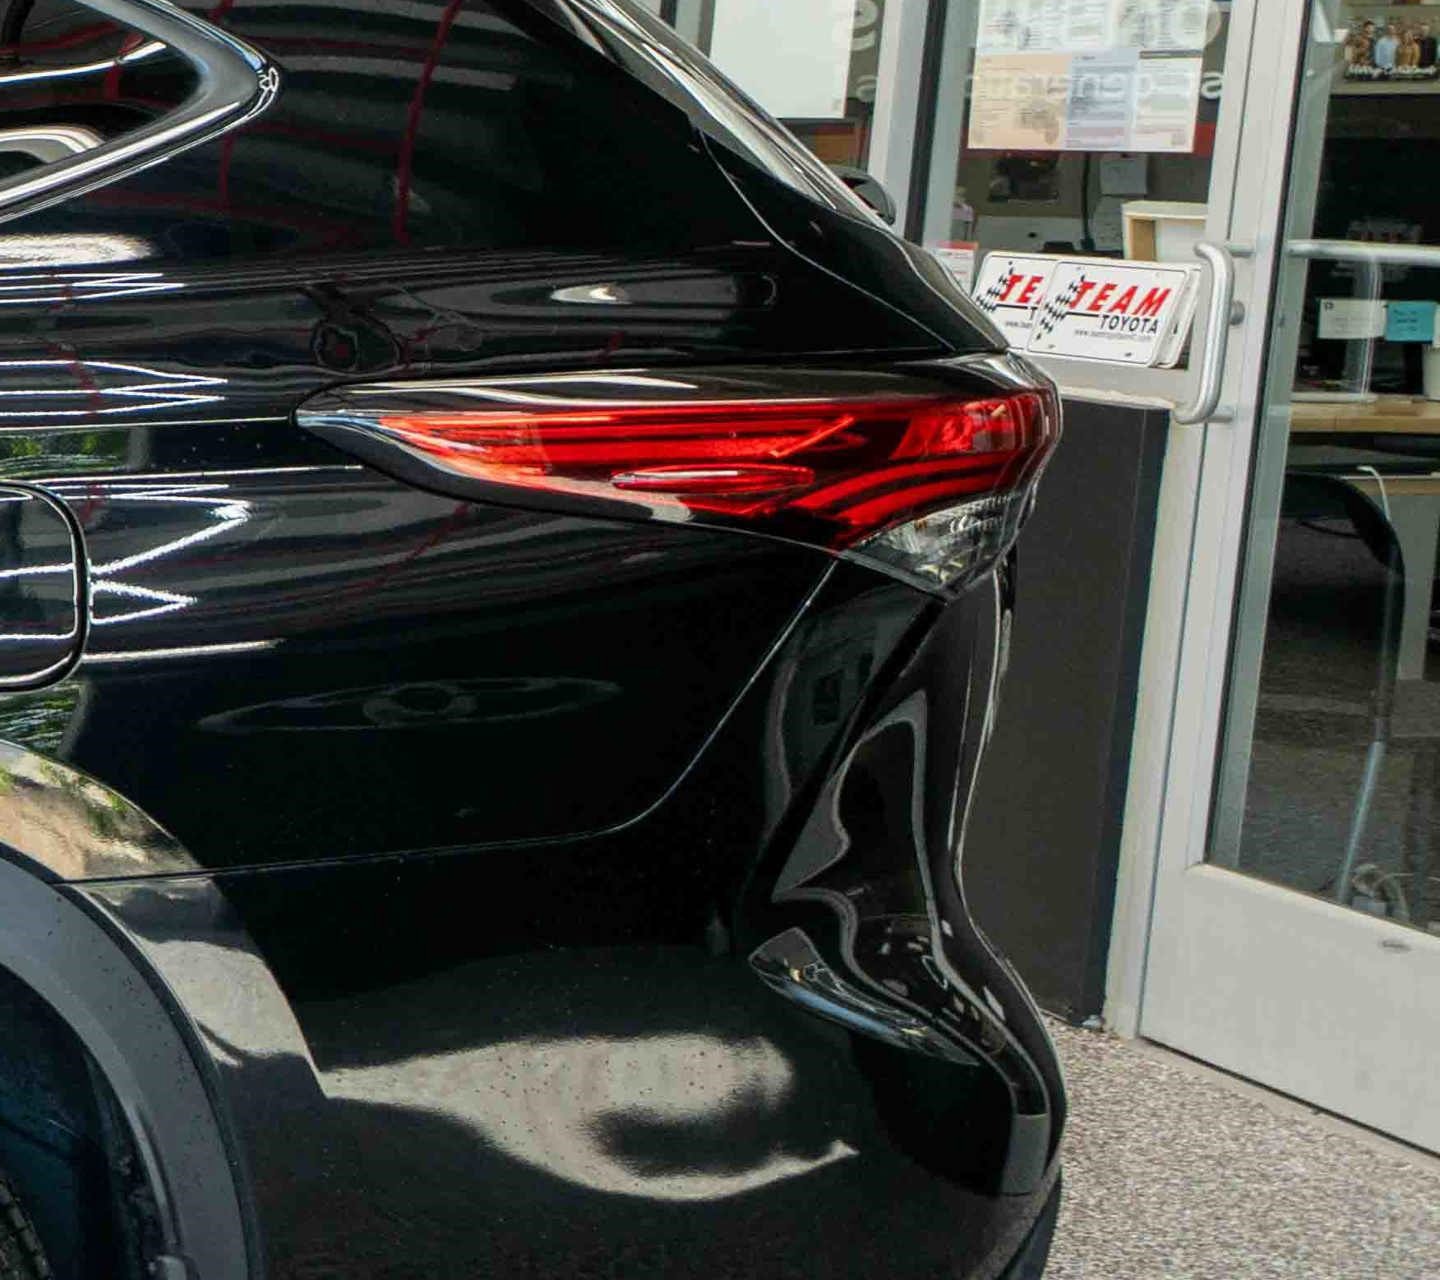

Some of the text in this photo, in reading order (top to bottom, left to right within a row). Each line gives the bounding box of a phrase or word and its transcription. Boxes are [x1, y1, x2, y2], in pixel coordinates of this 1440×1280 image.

[997, 274, 1044, 304] TE
[1068, 280, 1173, 317] TEAM
[1098, 314, 1160, 335] TOYOTA
